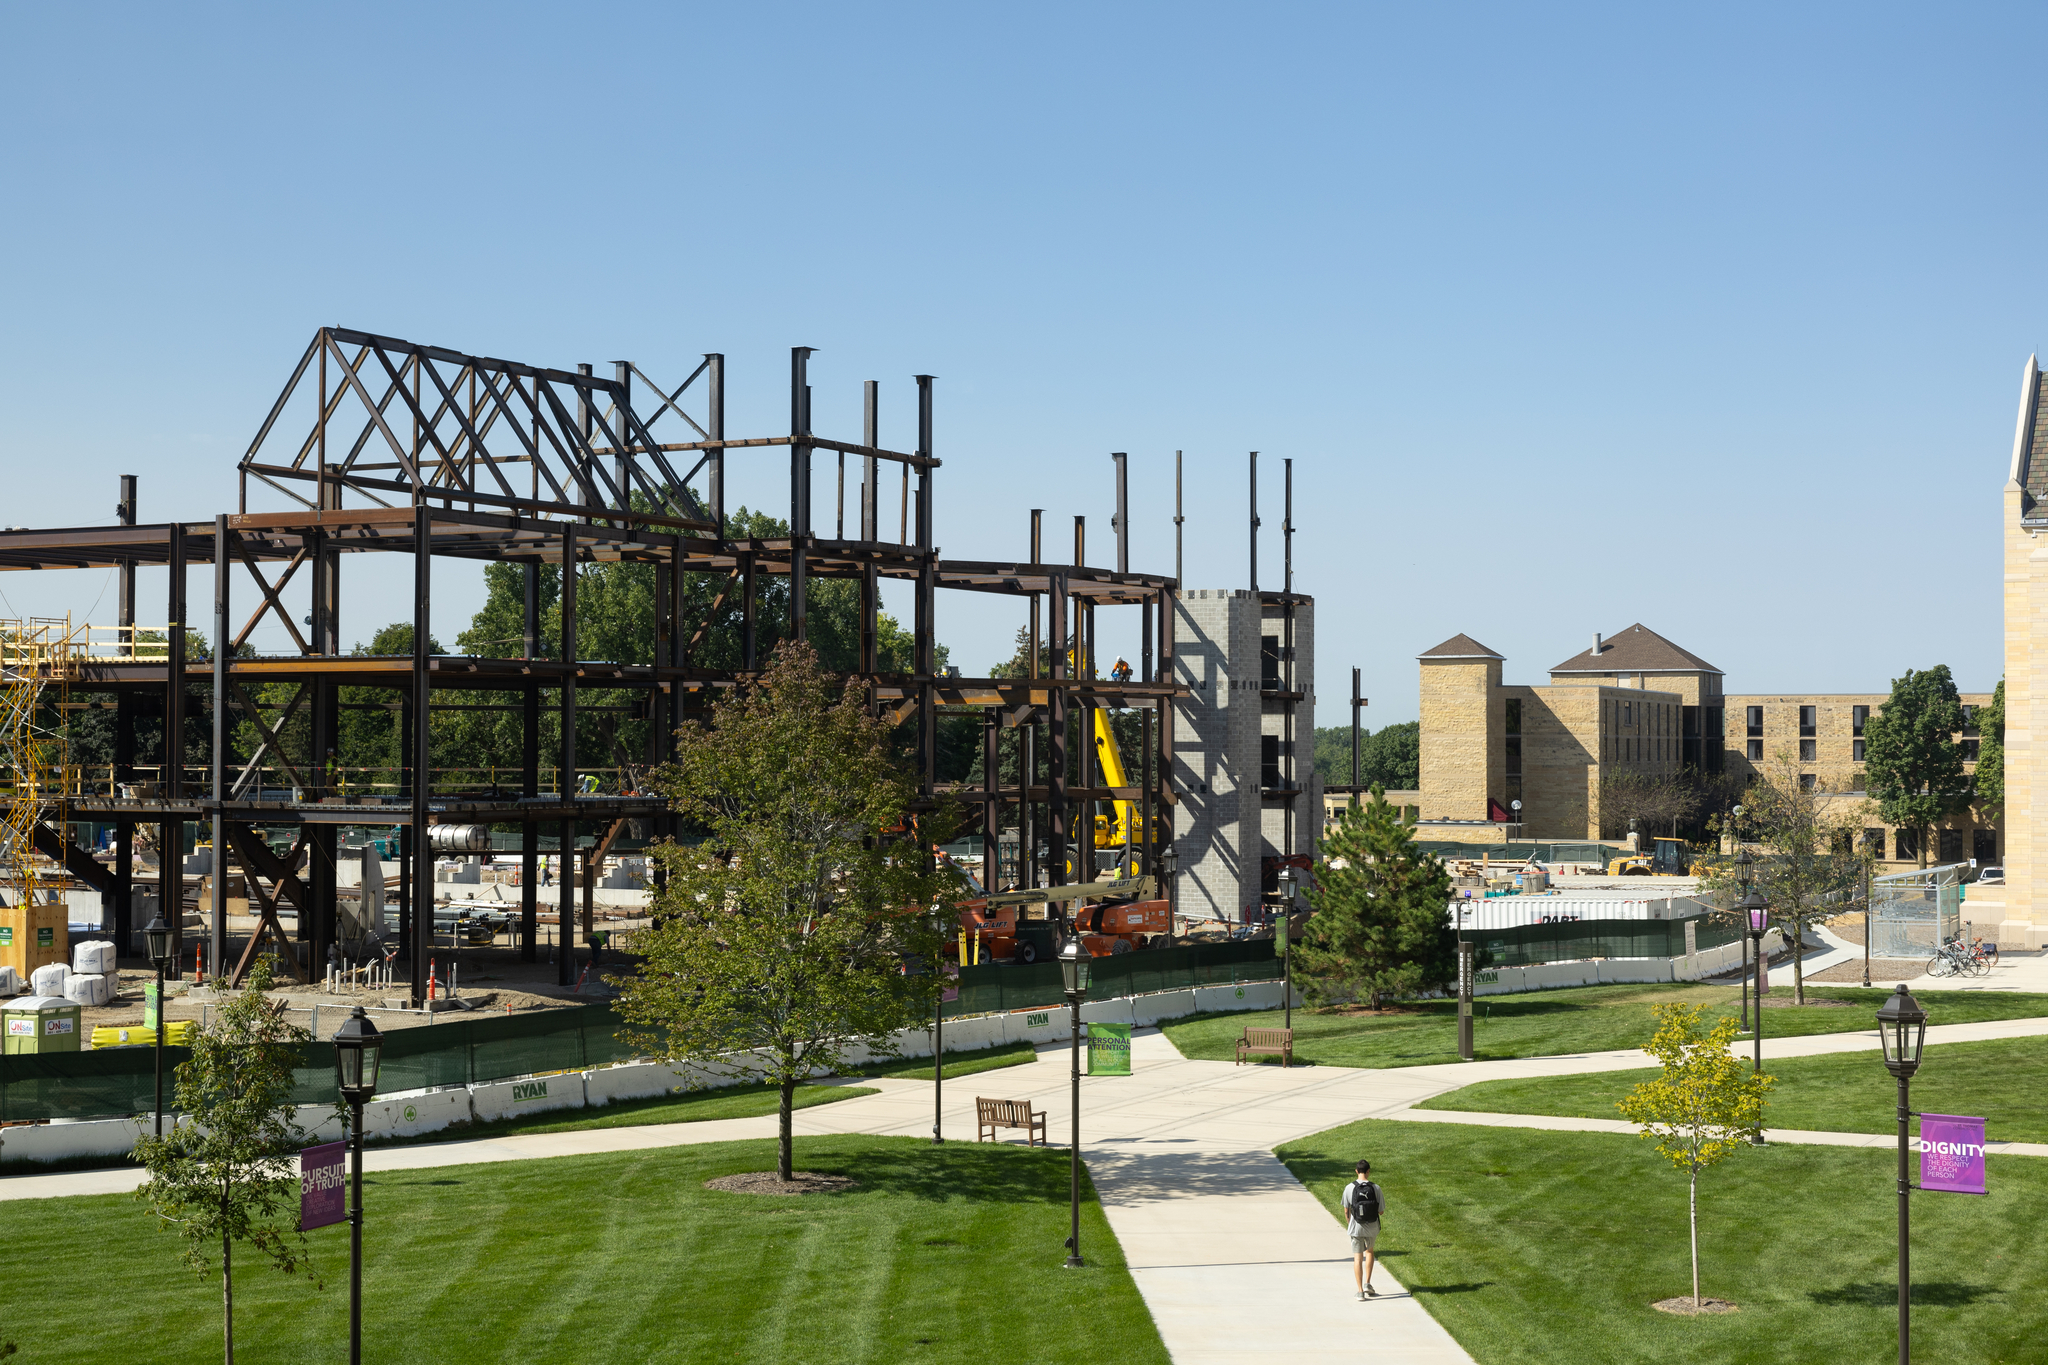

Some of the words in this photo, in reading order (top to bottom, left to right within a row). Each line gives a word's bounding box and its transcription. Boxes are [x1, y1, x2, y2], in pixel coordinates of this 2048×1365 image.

[1475, 971, 1498, 983] RYAN
[1027, 1012, 1049, 1026] RYAN
[1087, 1037, 1130, 1045] PERSONAL
[513, 1082, 547, 1099] RYAN
[1920, 1140, 1985, 1157] DIGNITY
[1940, 1154, 1969, 1162] RESPECT
[301, 1162, 345, 1184] PURSUIT
[1927, 1171, 1955, 1179] PERSON
[301, 1181, 314, 1195] OF
[316, 1175, 345, 1191] TRUTH
